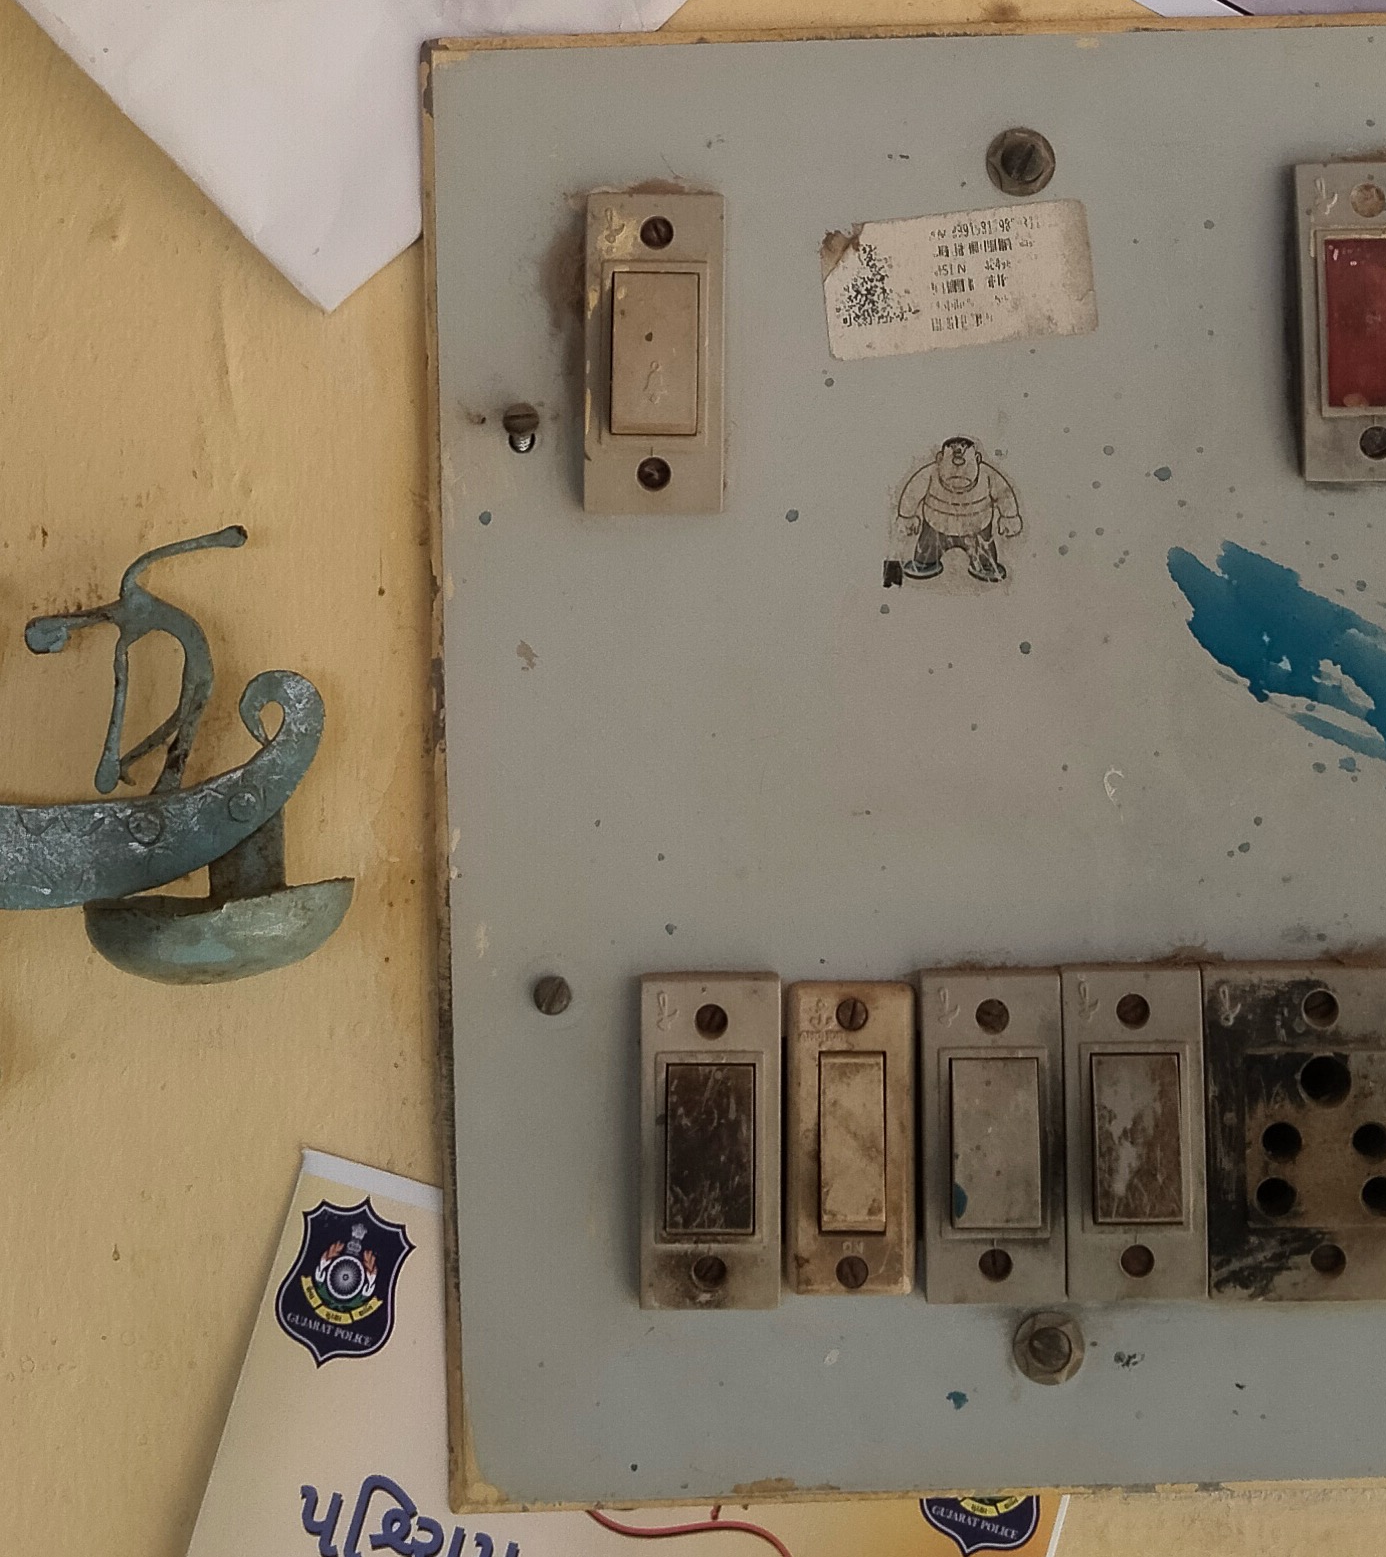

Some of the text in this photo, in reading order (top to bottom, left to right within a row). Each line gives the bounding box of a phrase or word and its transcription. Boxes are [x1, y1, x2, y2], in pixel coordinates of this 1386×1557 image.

[287, 1312, 335, 1335] GUJARAT
[334, 1327, 372, 1346] POLICE
[931, 1505, 980, 1527] GUJARAT
[980, 1519, 1019, 1540] POLICE
